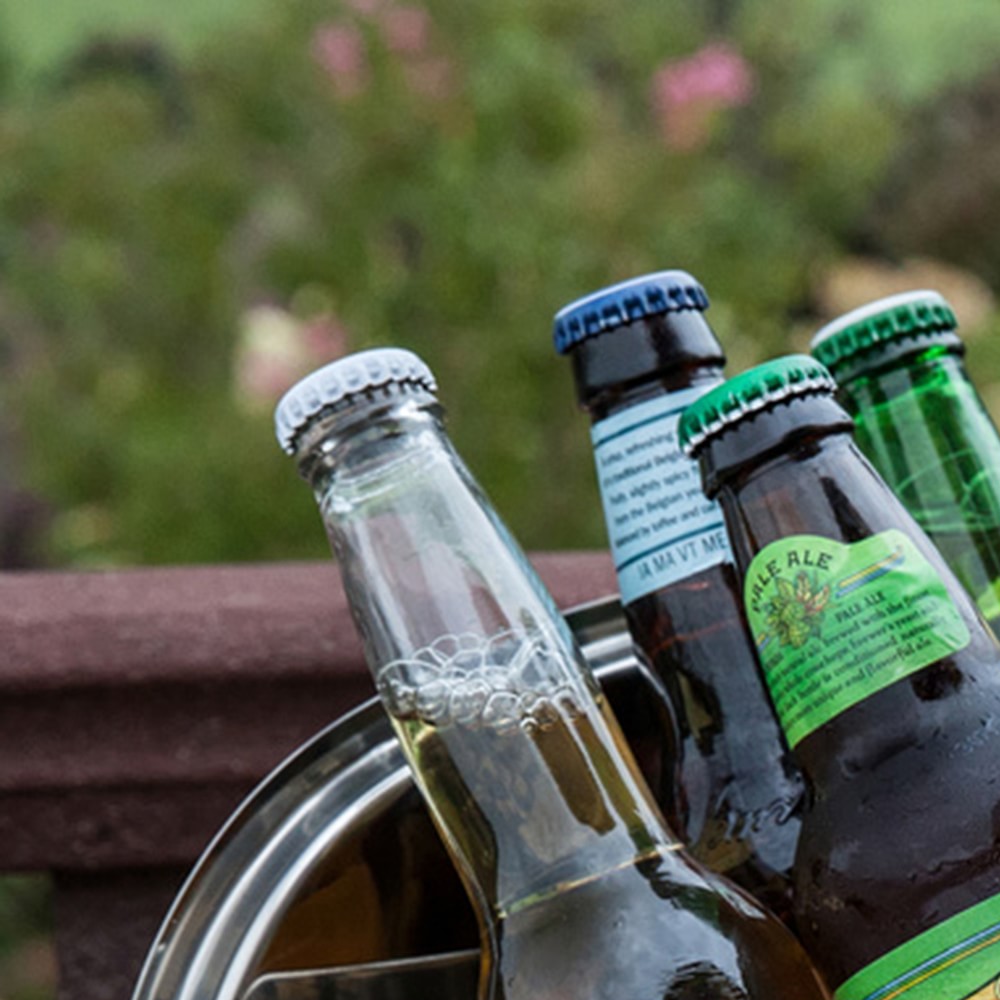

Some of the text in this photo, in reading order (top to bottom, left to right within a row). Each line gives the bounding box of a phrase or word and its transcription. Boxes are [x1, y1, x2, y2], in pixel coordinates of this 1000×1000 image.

[652, 551, 677, 574] MA
[675, 540, 698, 562] VT
[787, 549, 833, 571] ALE
